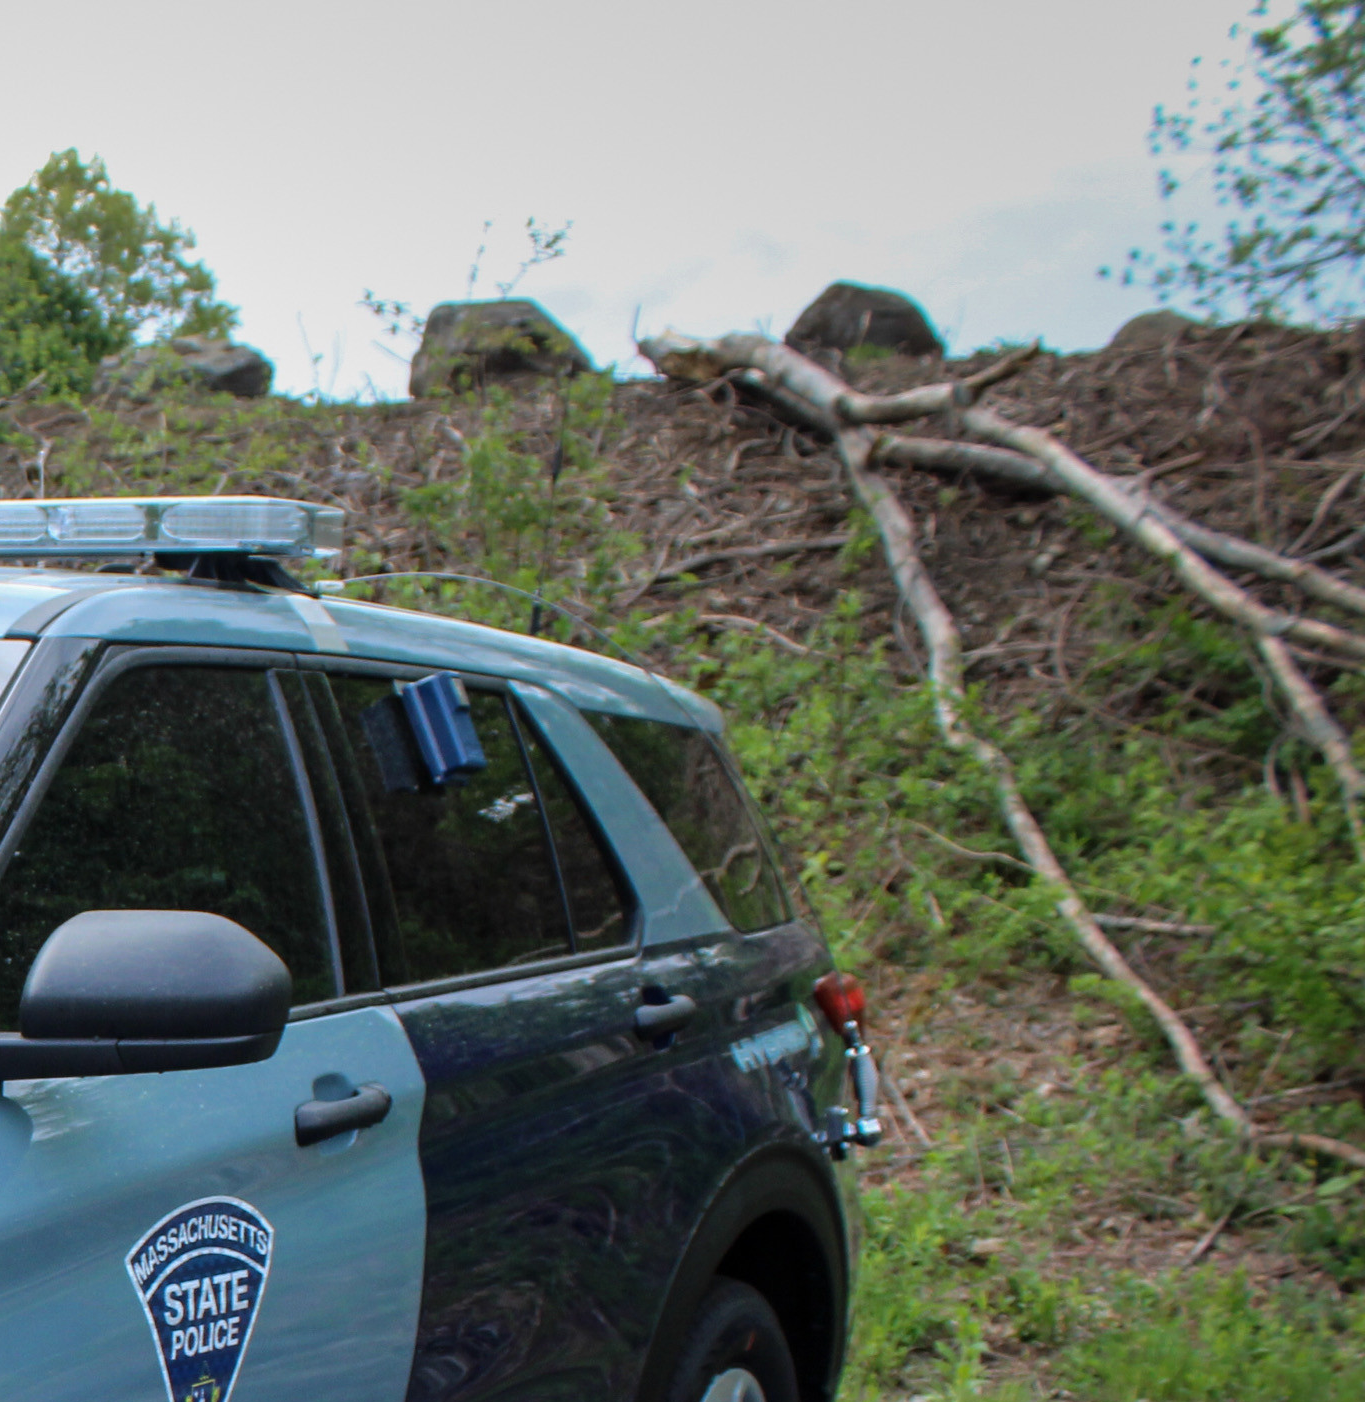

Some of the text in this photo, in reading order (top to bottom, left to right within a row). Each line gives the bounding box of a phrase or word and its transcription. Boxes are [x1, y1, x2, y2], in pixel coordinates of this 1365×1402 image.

[133, 1213, 268, 1285] MASSACHUSETTS
[163, 1269, 249, 1326] STATE
[171, 1316, 241, 1360] POLICE
